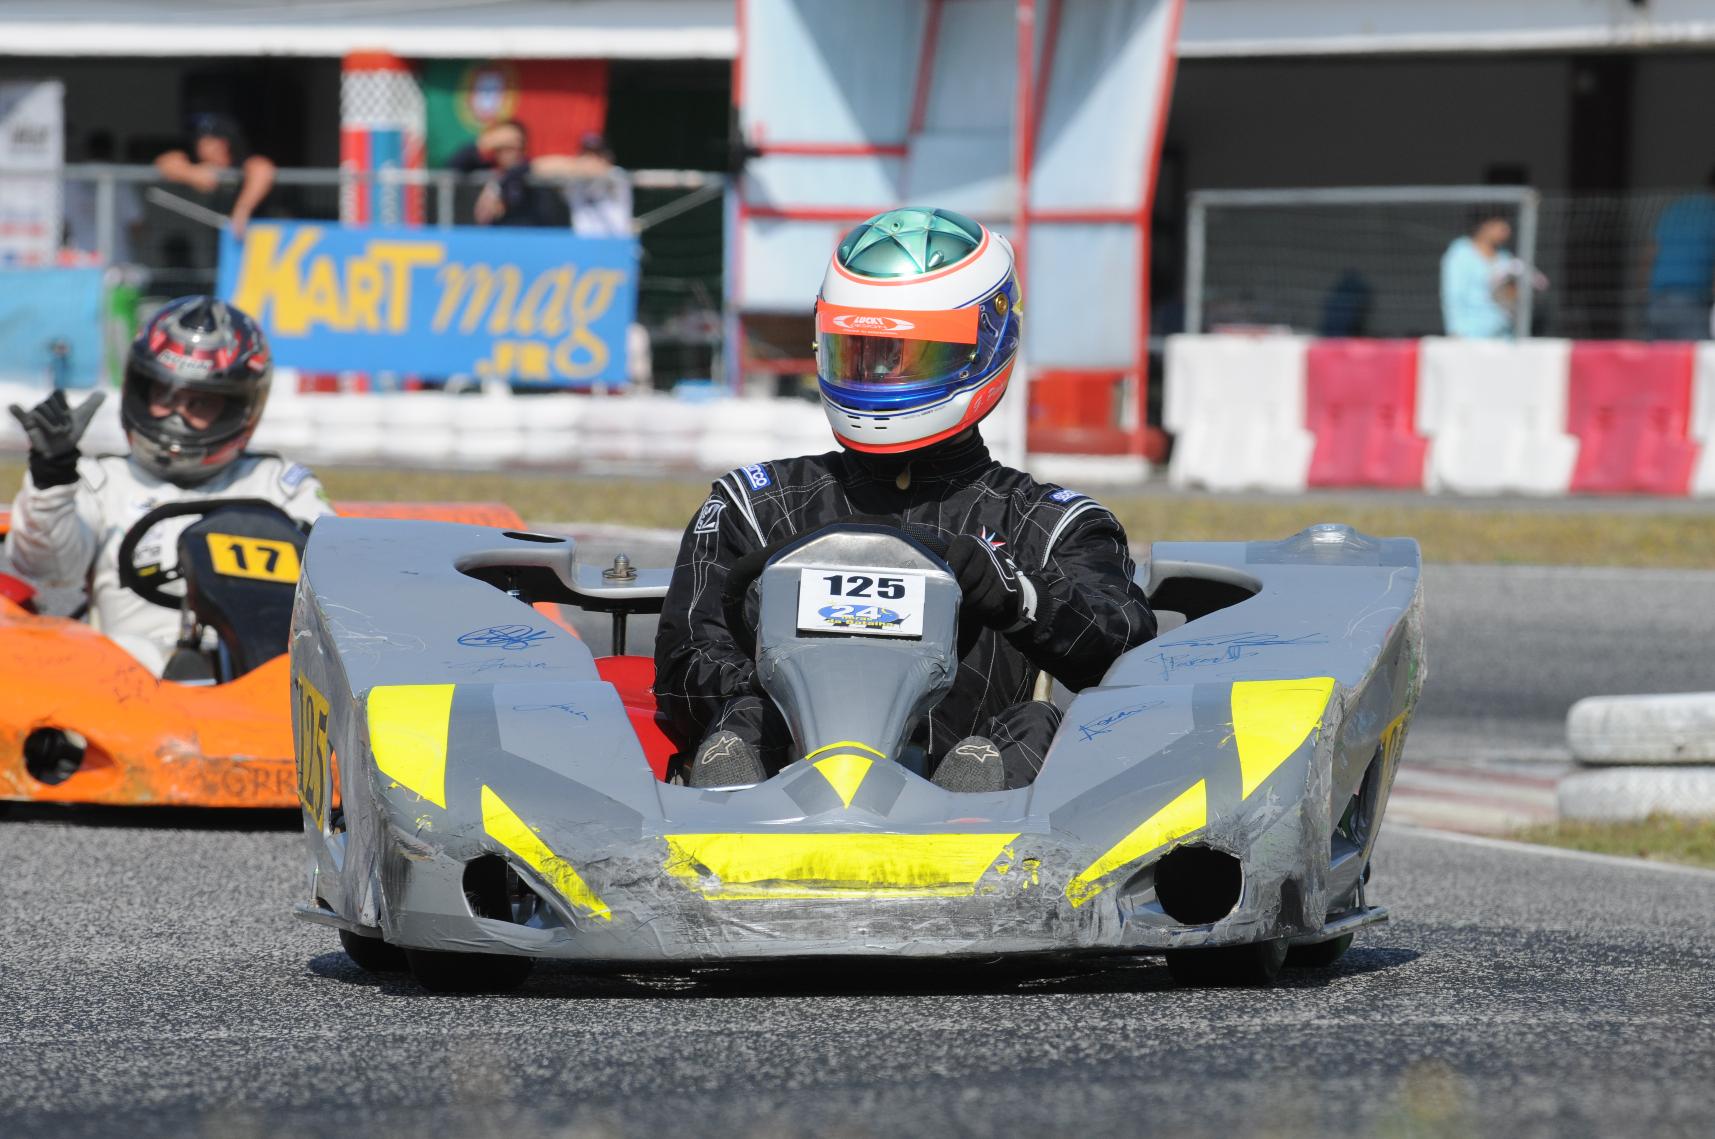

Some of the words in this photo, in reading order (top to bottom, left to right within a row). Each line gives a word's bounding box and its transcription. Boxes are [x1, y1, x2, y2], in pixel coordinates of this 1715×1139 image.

[236, 226, 446, 335] KART
[853, 316, 884, 325] LUCKY
[228, 543, 280, 574] 17
[822, 575, 906, 600] 125
[831, 605, 882, 620] 24
